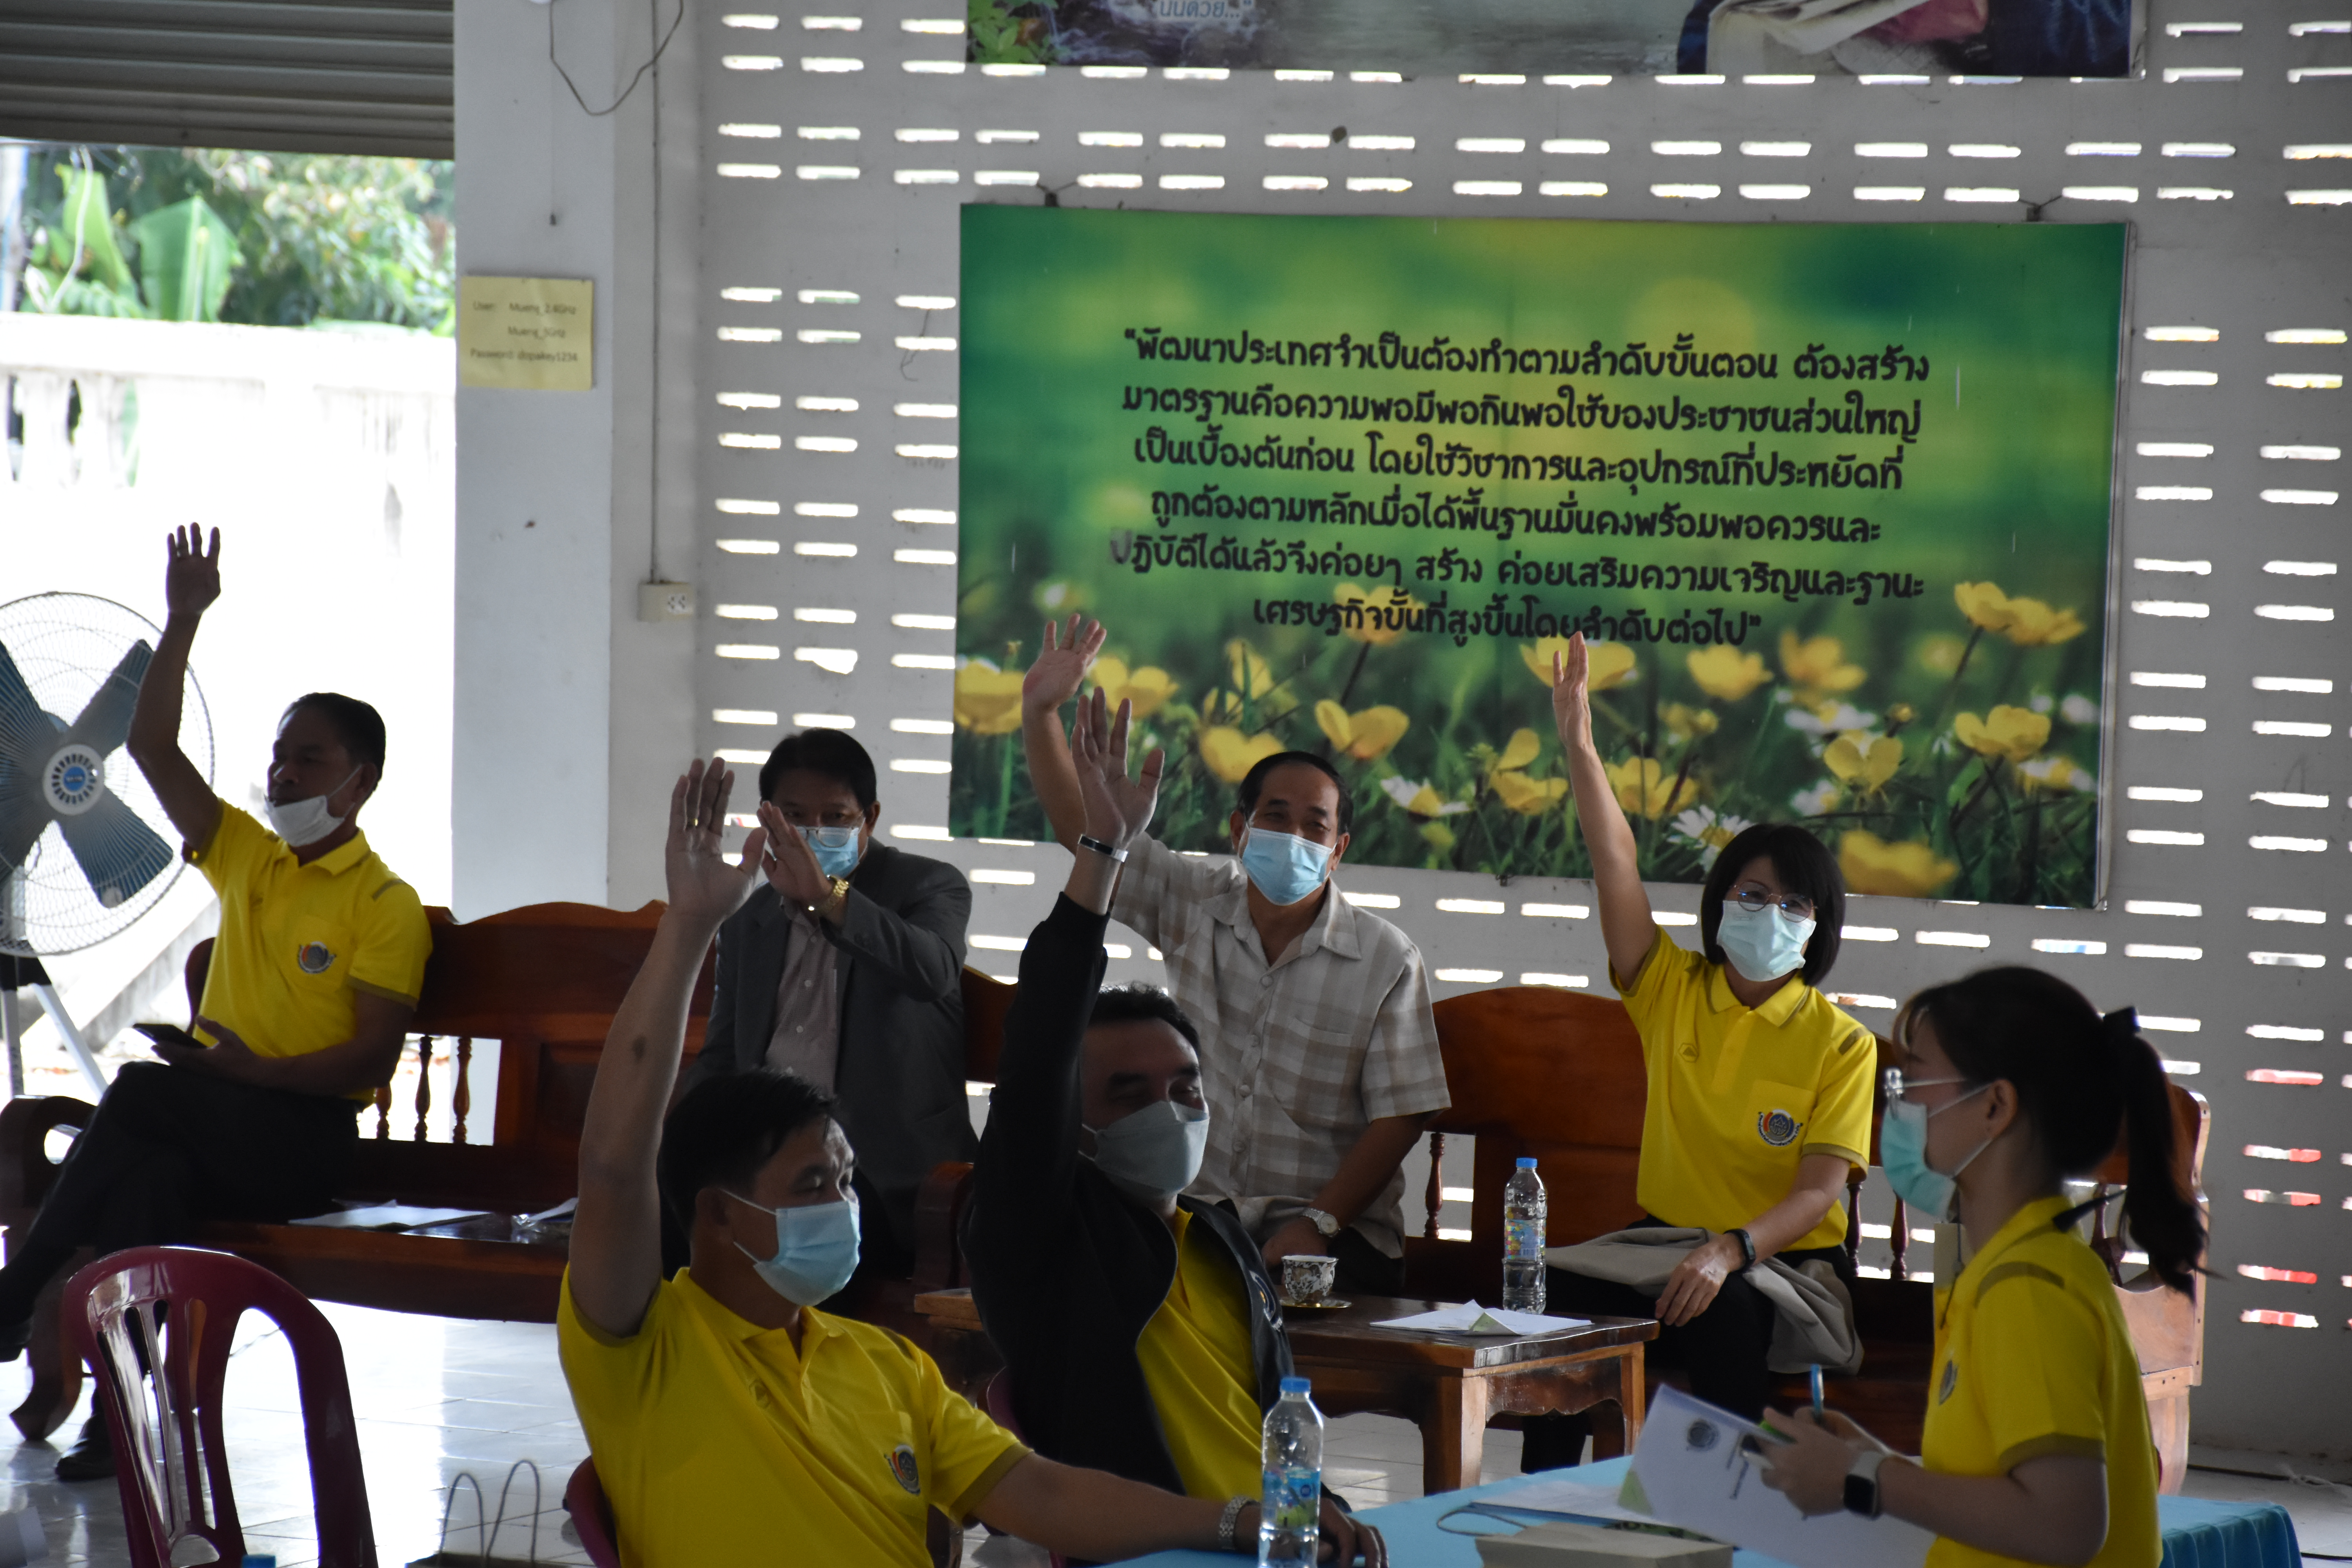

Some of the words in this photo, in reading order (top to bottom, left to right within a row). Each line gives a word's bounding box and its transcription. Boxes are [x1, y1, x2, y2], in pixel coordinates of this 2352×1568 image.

[1793, 343, 1930, 381] ต้องสร้าง
[1122, 383, 1921, 444] มาตรฐานคือความพอมีพอกินพอใช้ของประชาชนส่วนใหญ่
[1134, 423, 1354, 472] เป็นเบื้องต้นก่อน
[1365, 430, 1904, 496] โดยใช้วิชาการและอุปกรณ์ที่ประหยัดที่
[1151, 483, 1882, 543] ถูกต้องตามหลักเมื่อได้พื้นฐานมั่นคงพร้อมพอควรและ
[1415, 547, 1483, 583] สร้าง
[1497, 550, 1925, 606] ค่อยเสริมความเจริญและฐานะ
